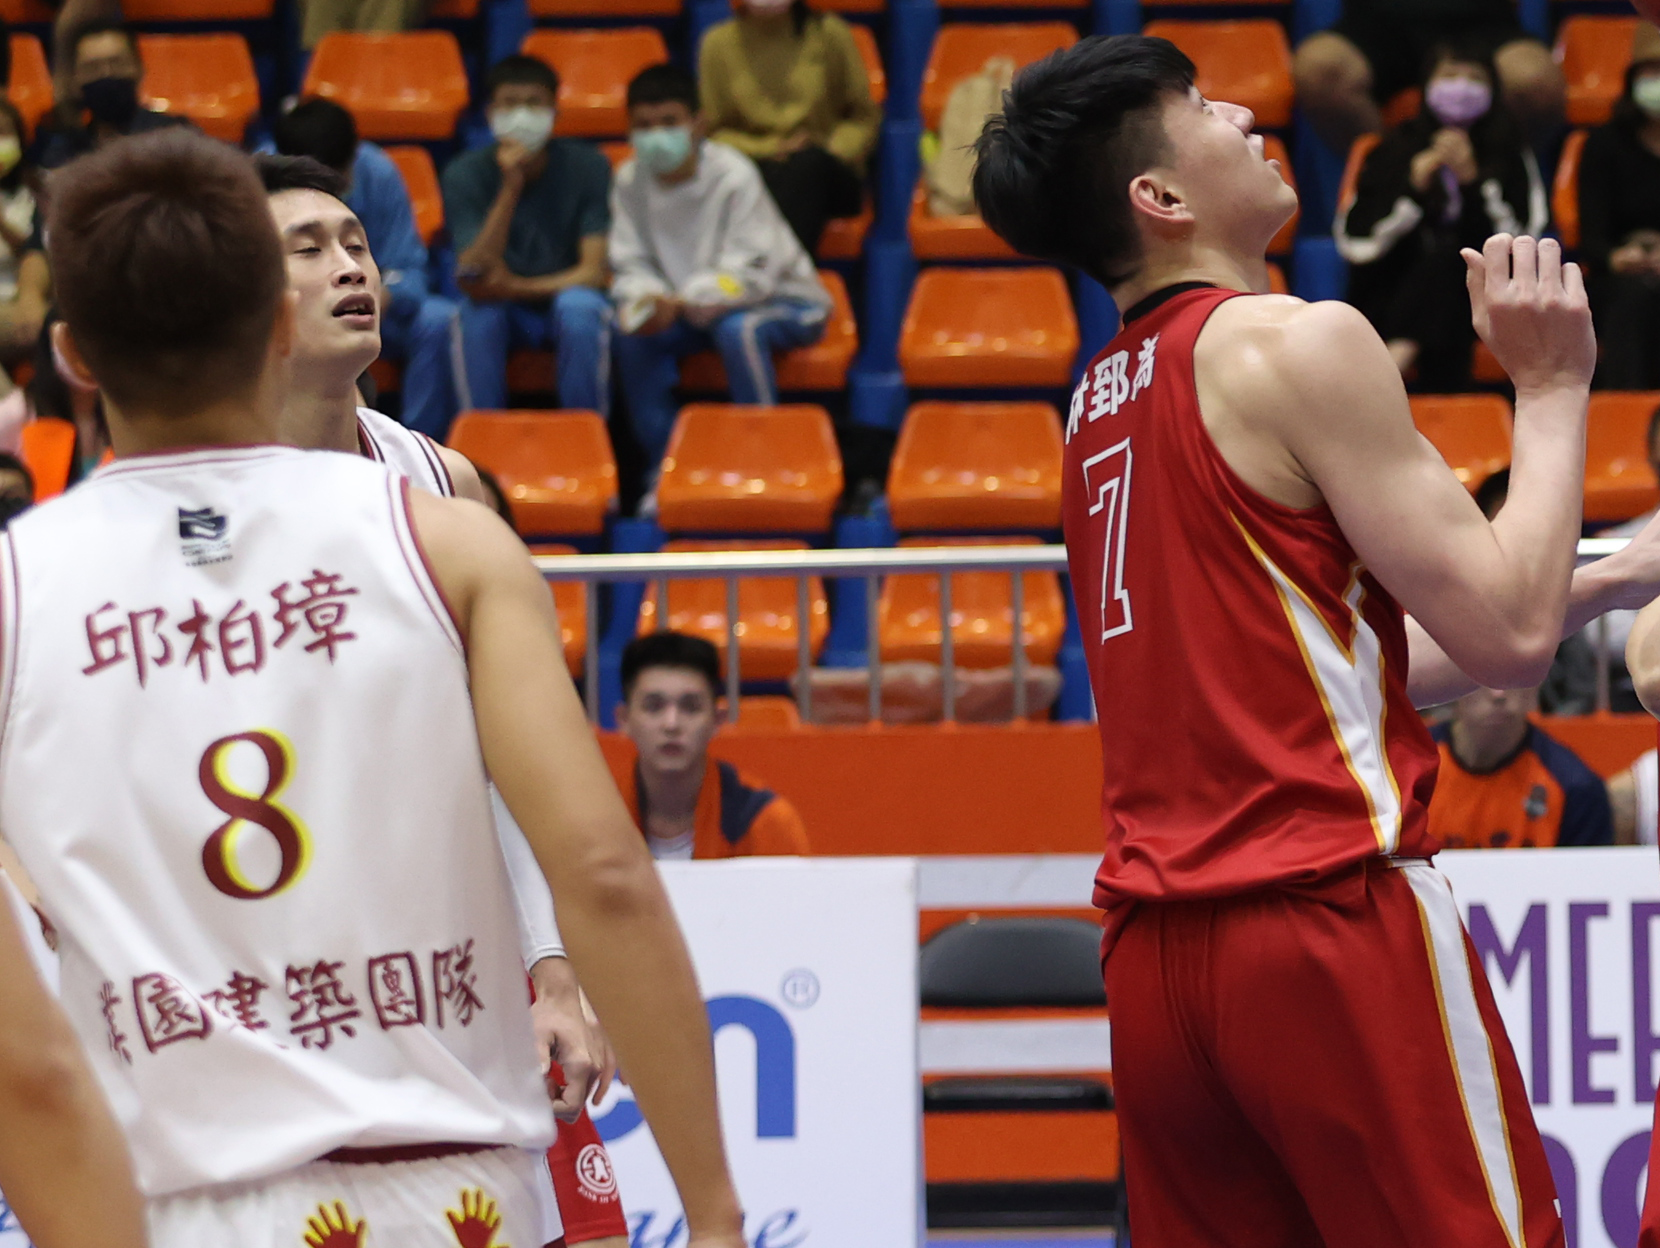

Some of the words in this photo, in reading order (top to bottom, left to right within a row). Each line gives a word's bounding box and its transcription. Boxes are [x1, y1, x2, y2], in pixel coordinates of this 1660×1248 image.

[1082, 436, 1133, 645] 7
[81, 569, 361, 690] 邱柏璋
[199, 727, 314, 900] 8
